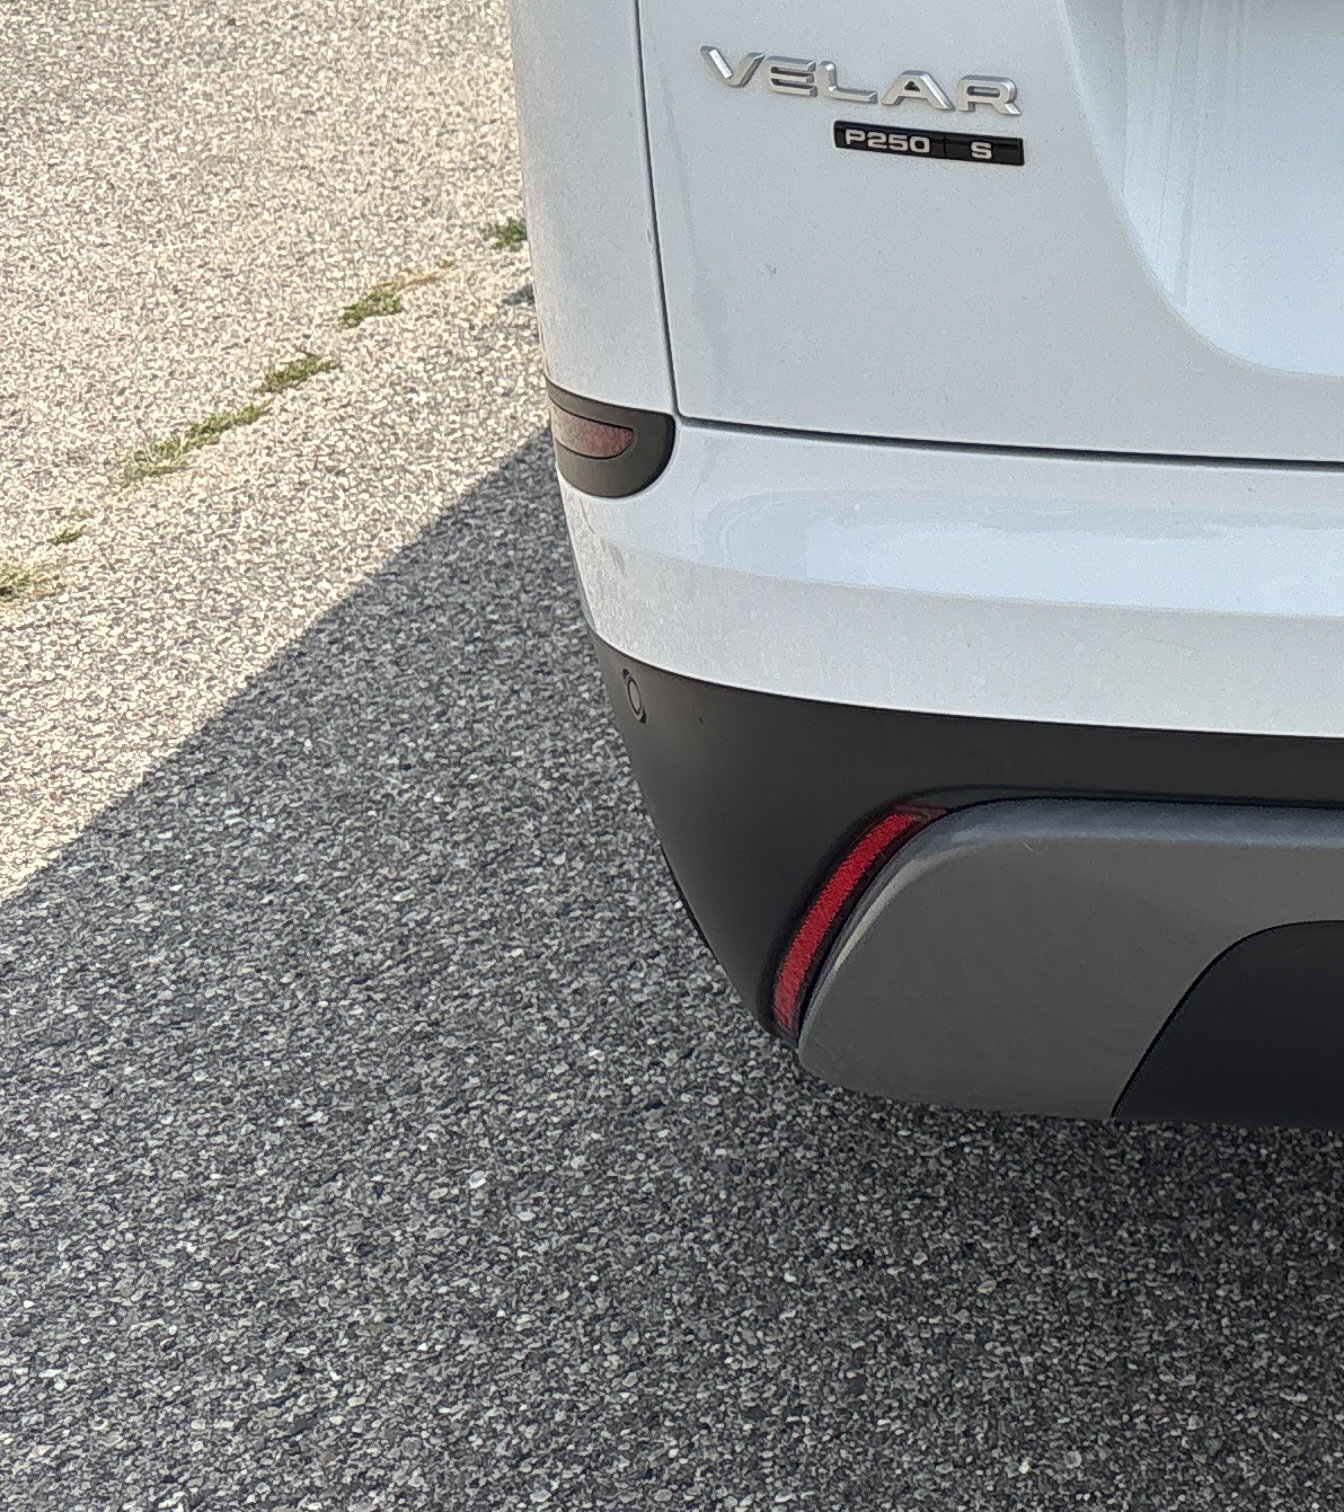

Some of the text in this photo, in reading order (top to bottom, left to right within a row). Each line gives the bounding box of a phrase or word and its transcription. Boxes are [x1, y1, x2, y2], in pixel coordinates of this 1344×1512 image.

[700, 45, 1022, 116] VELAR
[845, 128, 993, 161] P250 S
